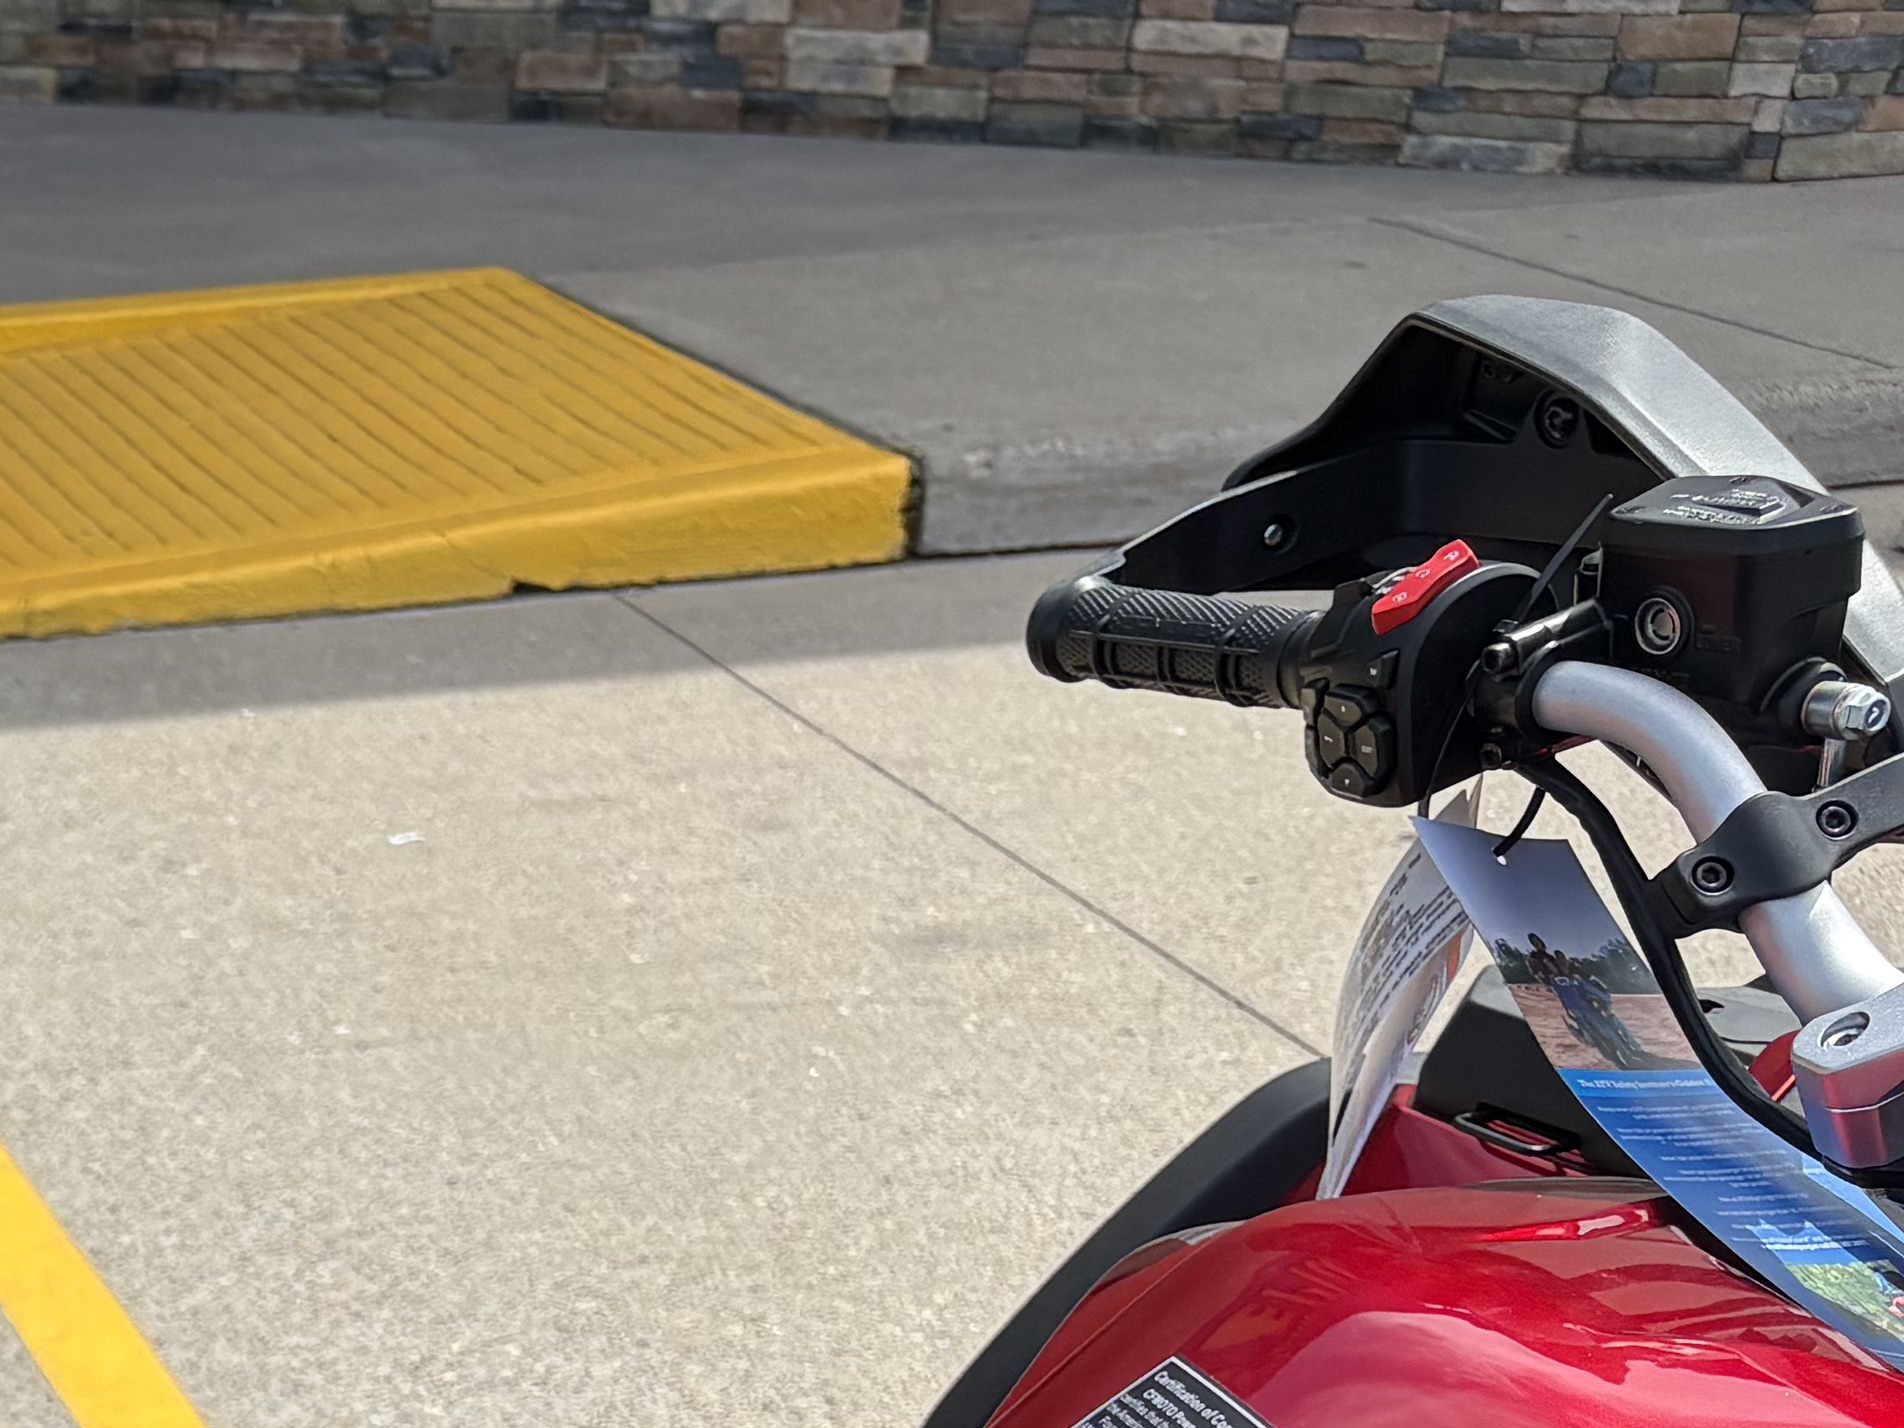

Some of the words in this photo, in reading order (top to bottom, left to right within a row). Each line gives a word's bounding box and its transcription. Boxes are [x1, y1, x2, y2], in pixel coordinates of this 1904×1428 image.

[1141, 1387, 1179, 1417] CFMOTO
[1152, 1369, 1208, 1413] Certification
[1199, 1406, 1220, 1420] of
